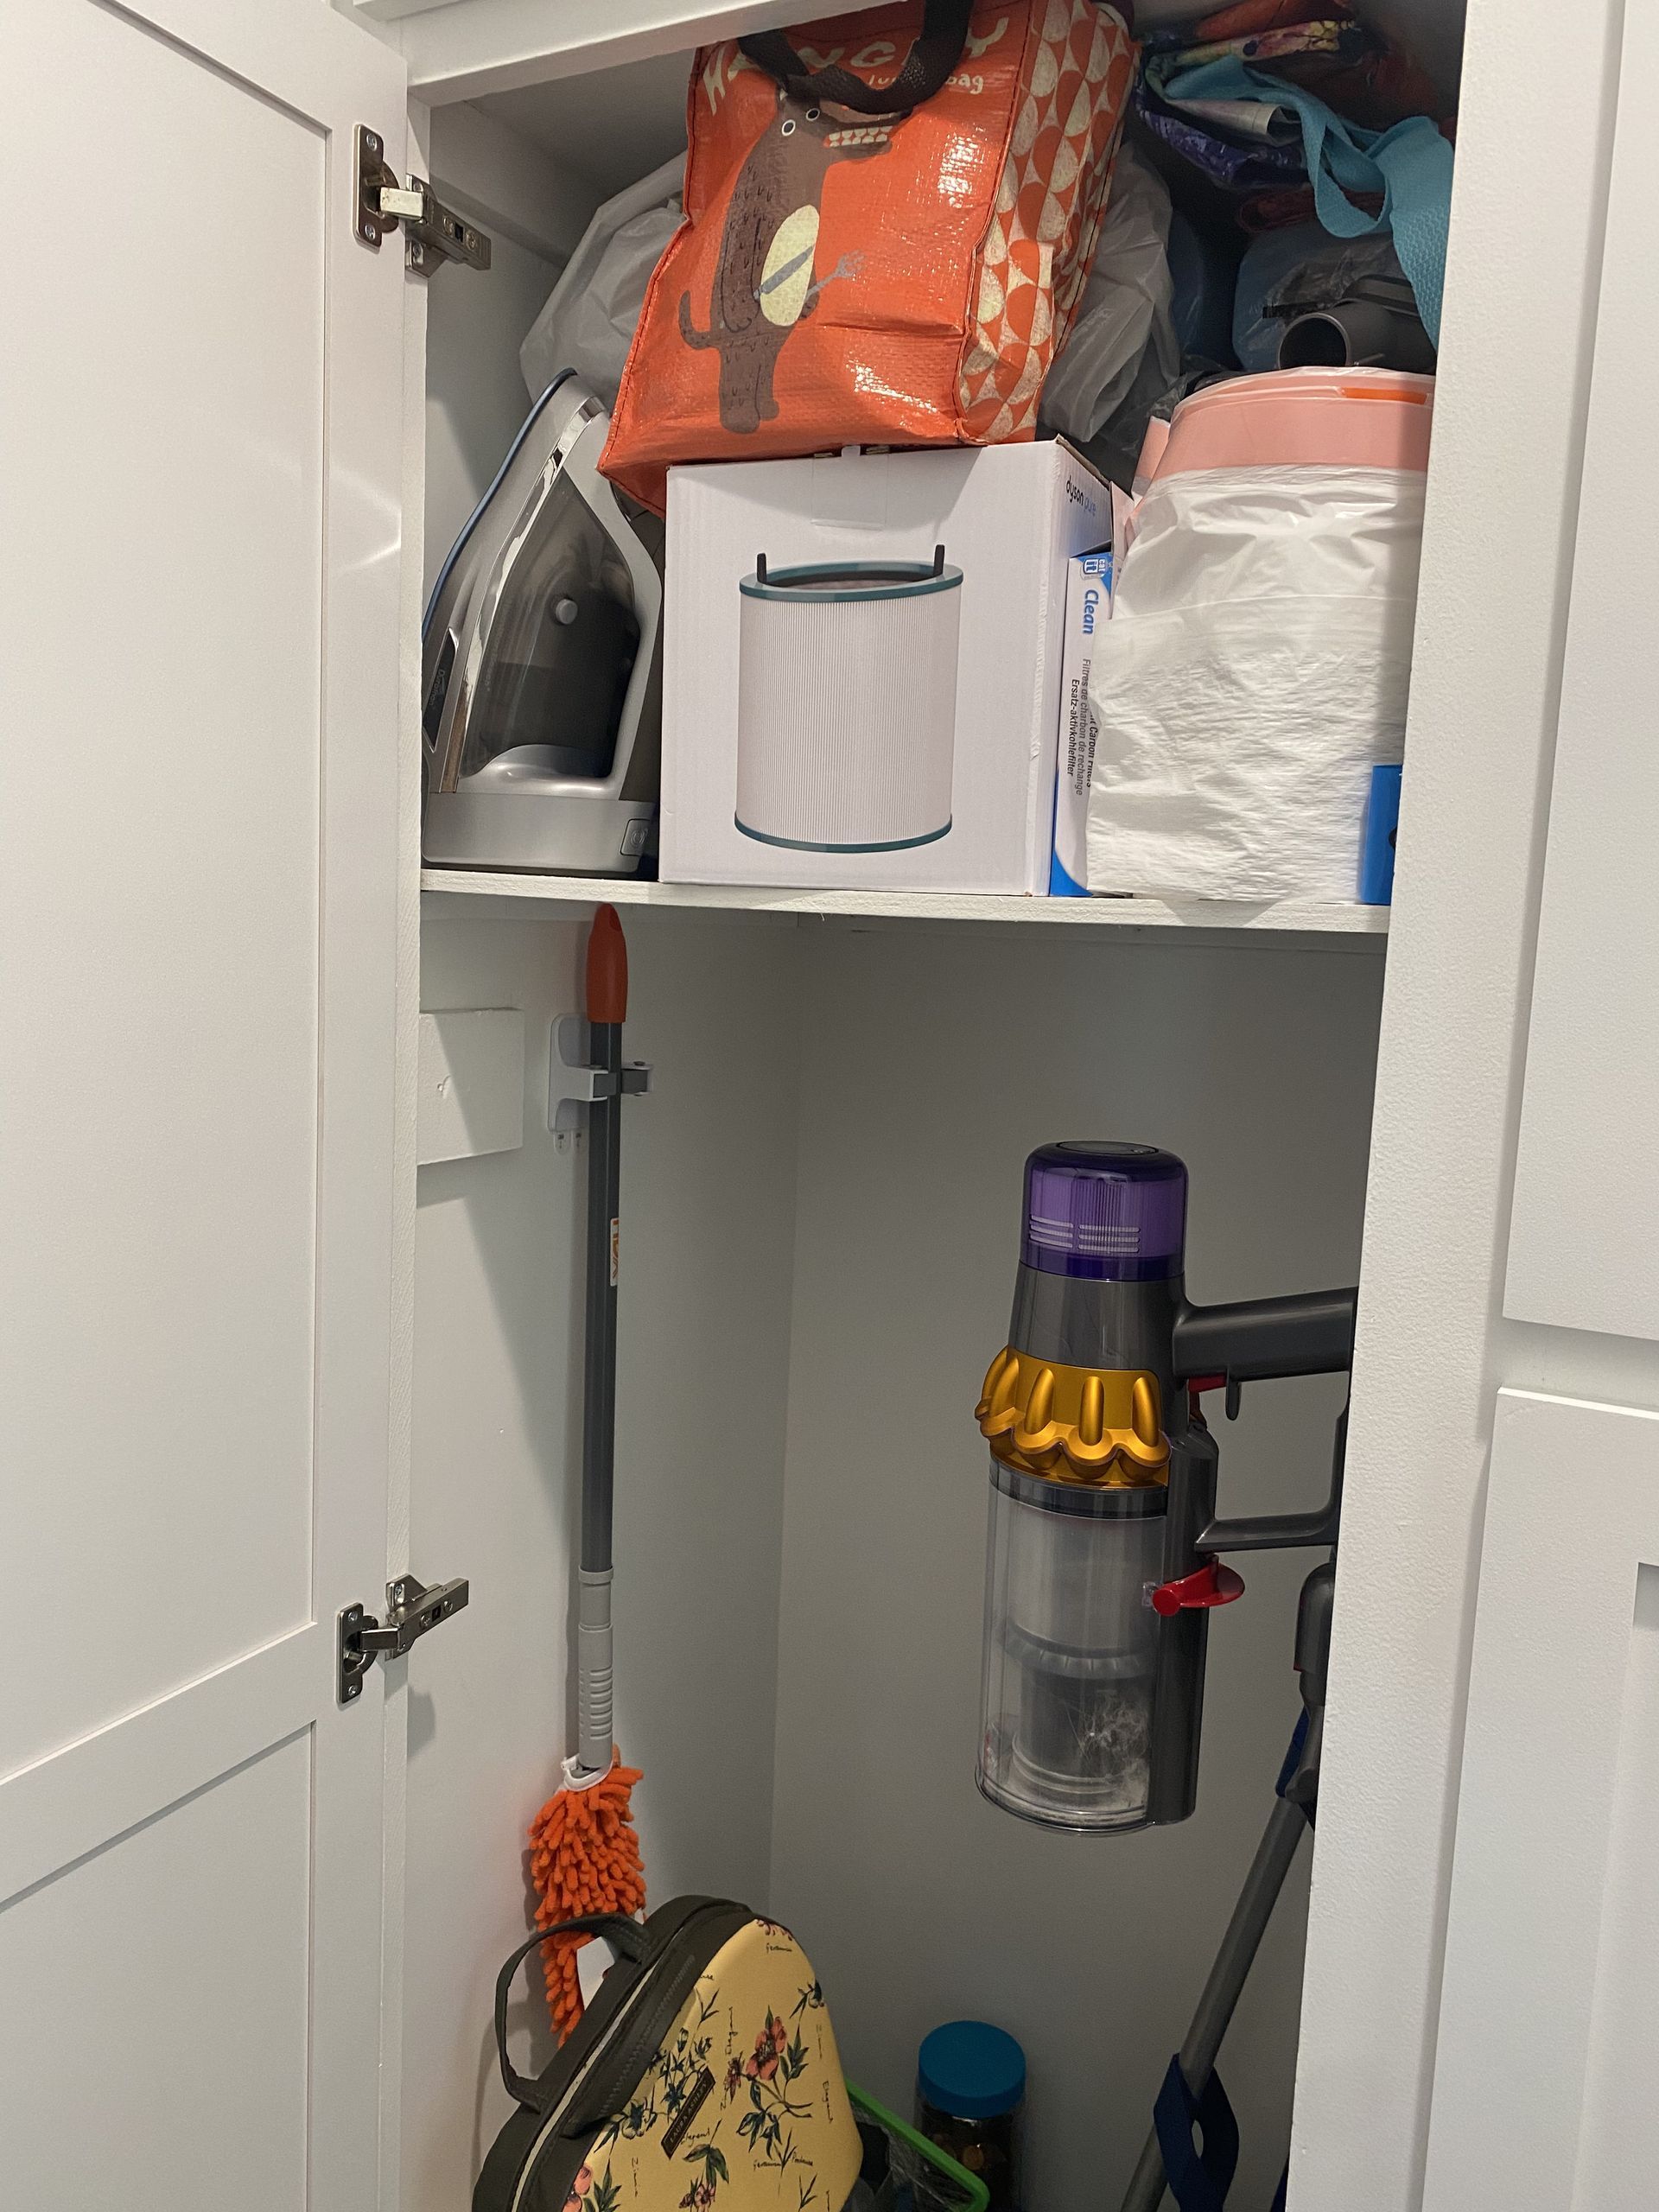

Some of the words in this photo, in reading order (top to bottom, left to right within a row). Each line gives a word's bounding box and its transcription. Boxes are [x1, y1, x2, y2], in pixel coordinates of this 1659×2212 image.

[1066, 475, 1084, 507] dyson
[1084, 559, 1098, 574] it
[1083, 589, 1099, 634] Clean
[1082, 658, 1091, 687] Filtres
[1081, 690, 1089, 700] de
[1066, 679, 1080, 776] Ersatz-aktivkohlefilter
[1079, 702, 1089, 739] charbon
[1078, 741, 1087, 753] de
[1075, 754, 1086, 795] rechange
